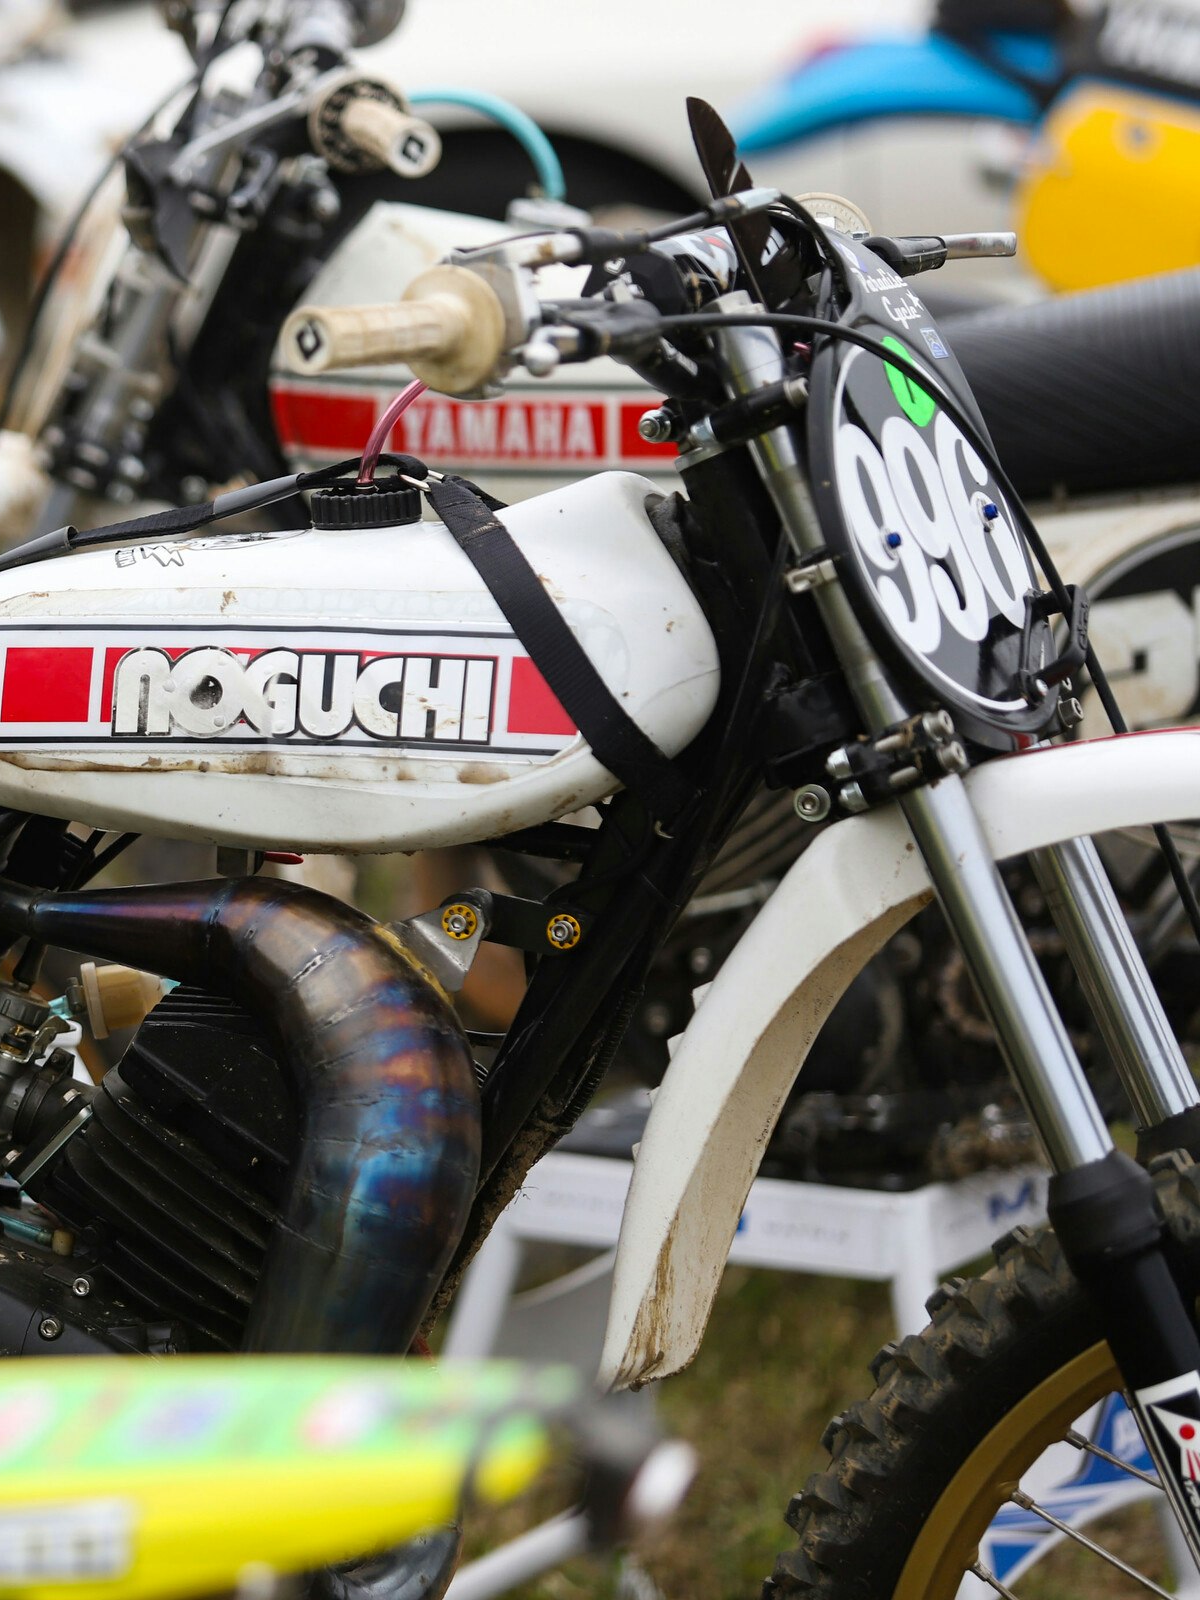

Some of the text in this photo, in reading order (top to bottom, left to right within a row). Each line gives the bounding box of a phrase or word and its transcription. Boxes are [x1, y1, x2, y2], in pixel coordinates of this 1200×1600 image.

[881, 295, 922, 330] Cycle
[400, 403, 600, 454] YAMAHA
[834, 410, 1031, 654] 996
[111, 646, 497, 745] NOGUCHI
